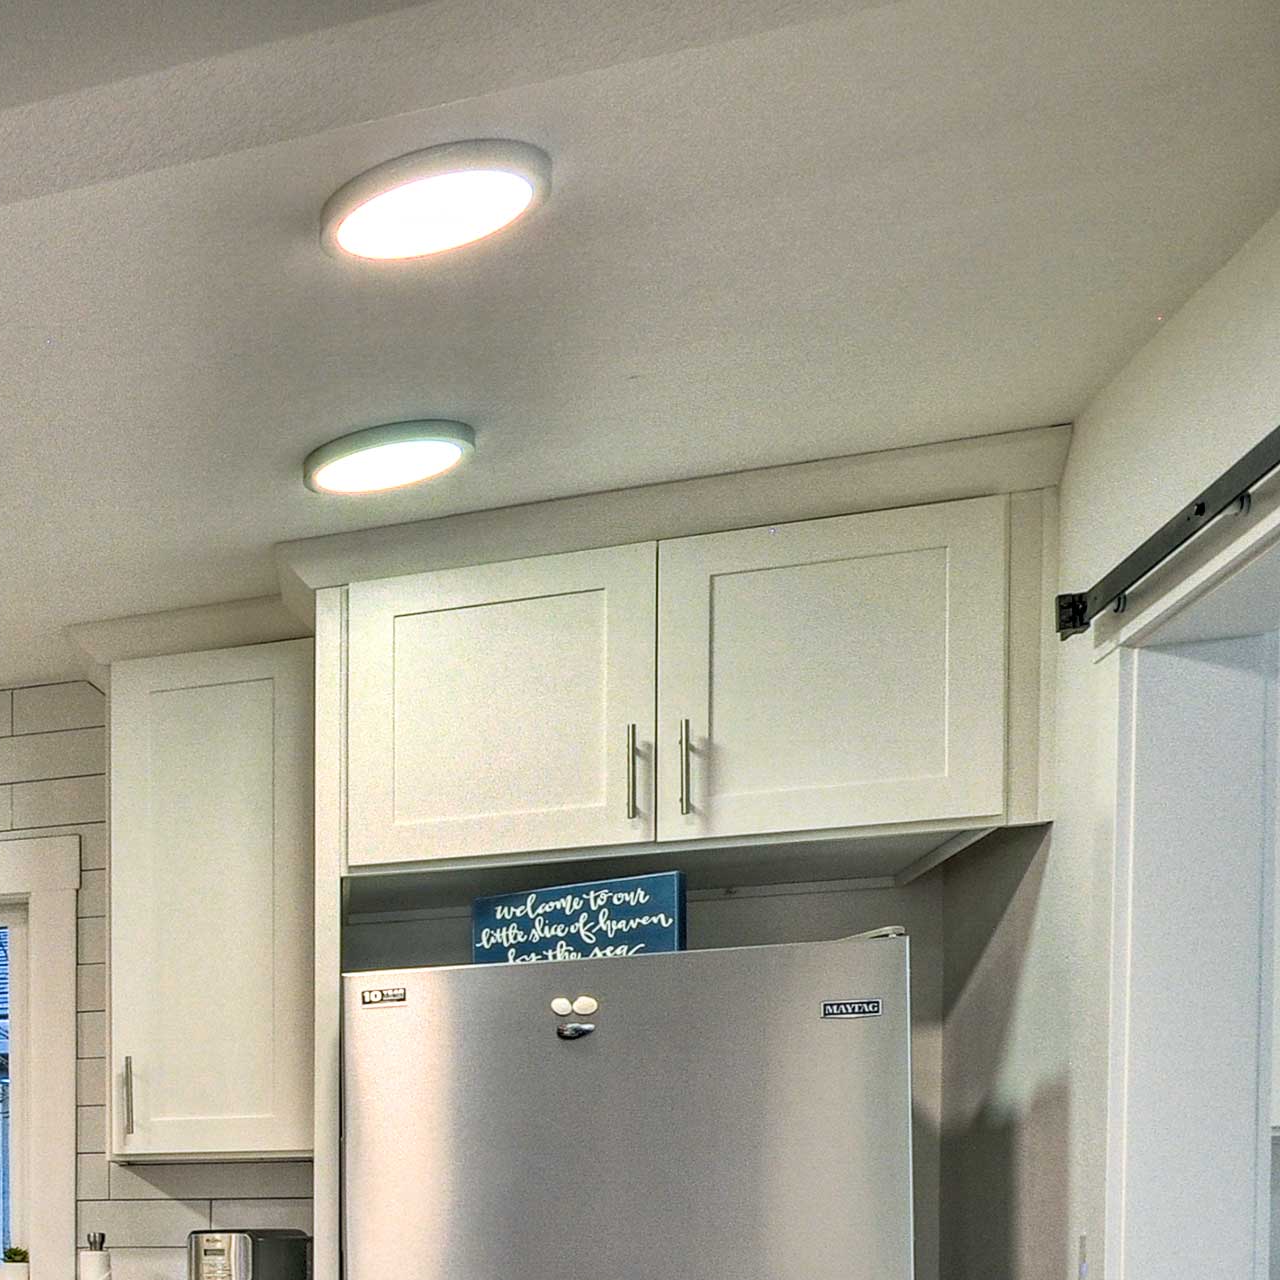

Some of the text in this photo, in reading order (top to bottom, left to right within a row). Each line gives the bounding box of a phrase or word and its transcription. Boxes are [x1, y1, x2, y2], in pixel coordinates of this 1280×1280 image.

[495, 887, 650, 919] welcome to our
[476, 908, 673, 949] little slice of heaven
[363, 990, 382, 1003] 10
[825, 1003, 878, 1014] MAYTAG
